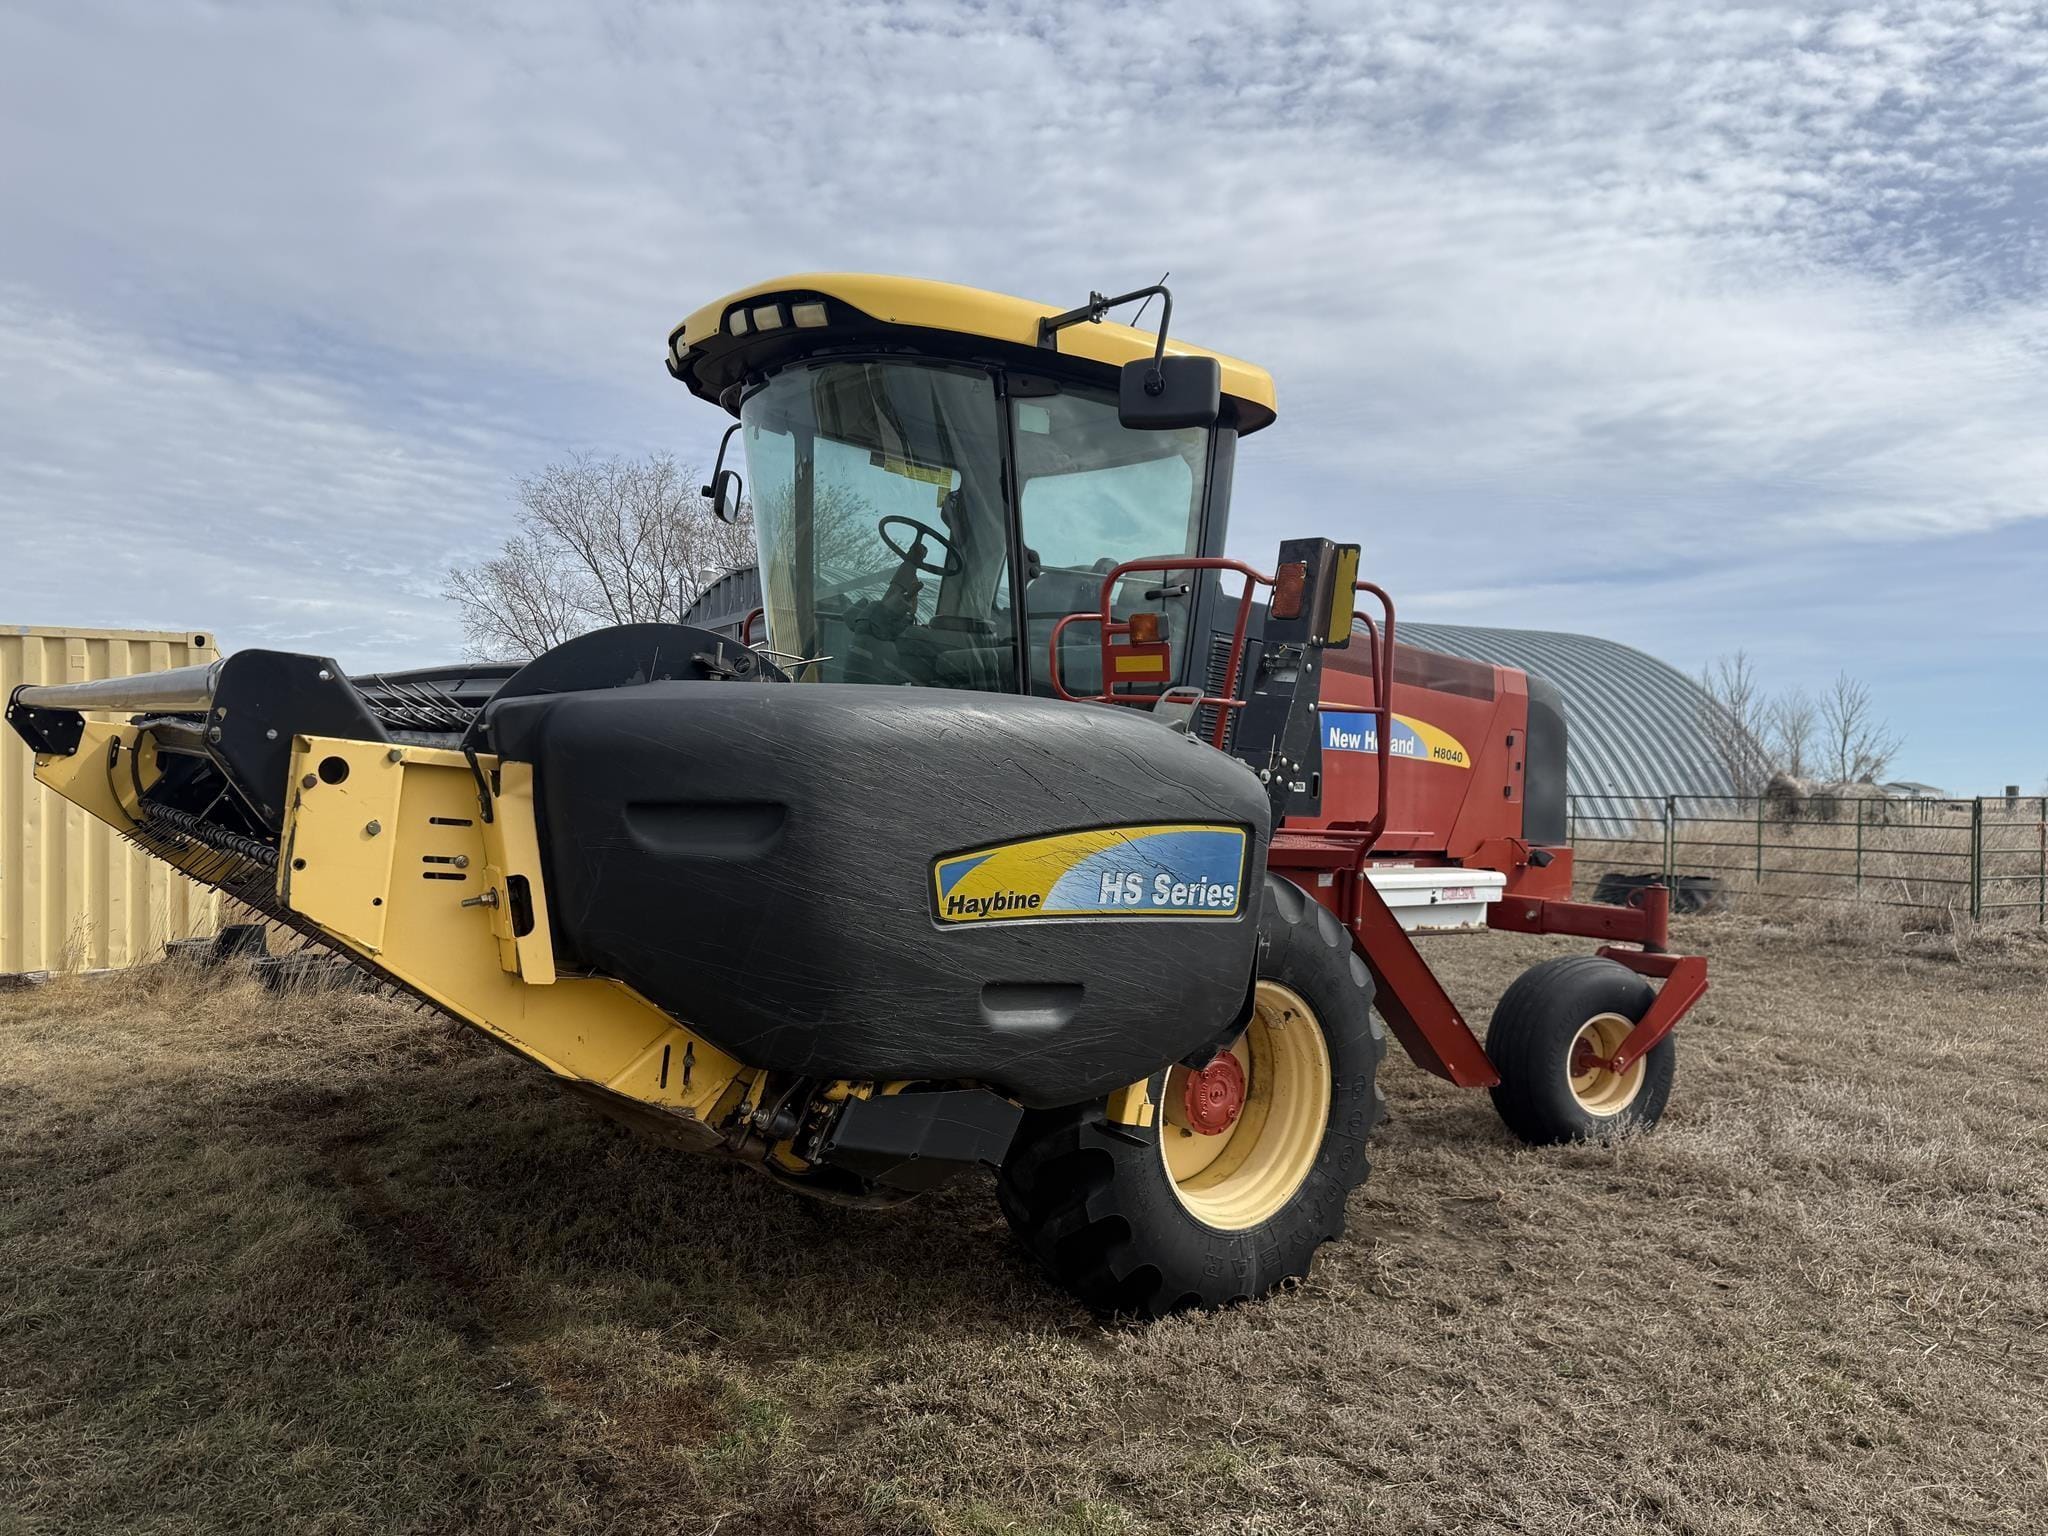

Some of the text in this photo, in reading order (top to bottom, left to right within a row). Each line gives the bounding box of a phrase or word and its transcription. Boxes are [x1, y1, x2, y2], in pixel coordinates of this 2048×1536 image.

[1329, 726, 1414, 755] New Hand
[1433, 746, 1463, 763] H8040
[1098, 870, 1235, 908] HS Series
[946, 890, 1041, 917] Haybine
